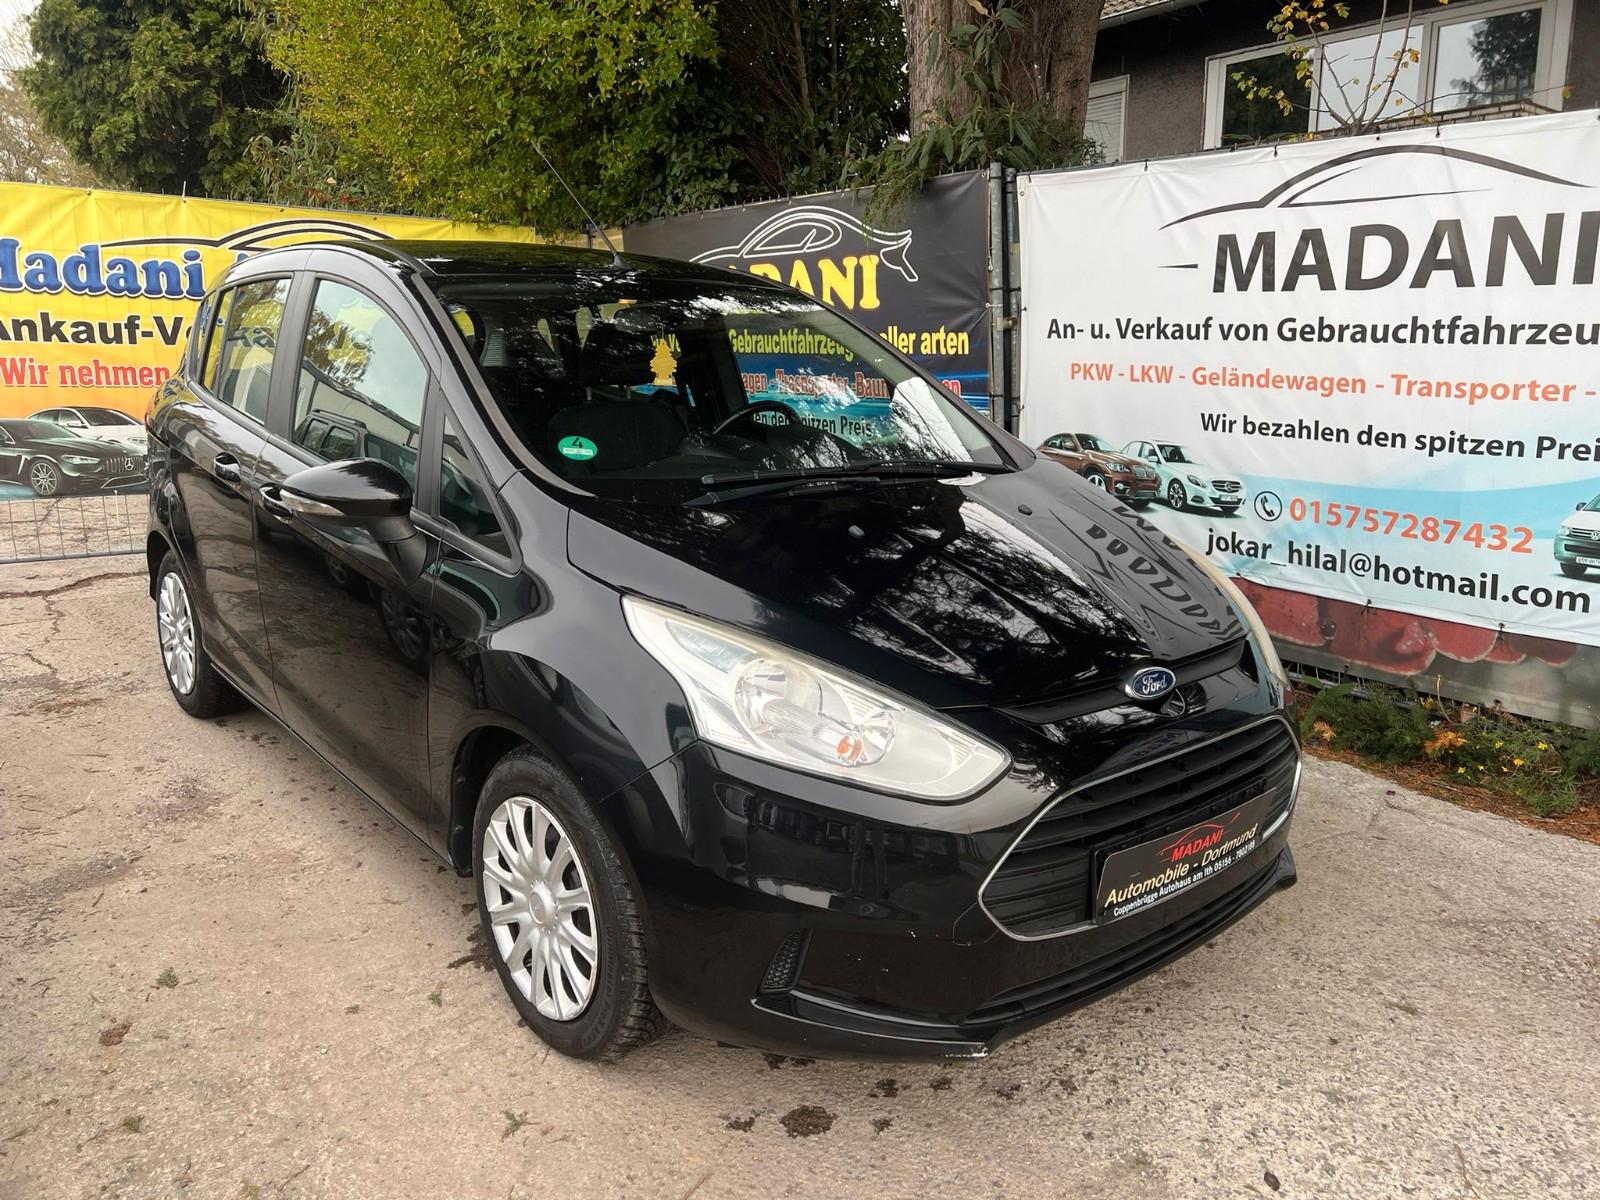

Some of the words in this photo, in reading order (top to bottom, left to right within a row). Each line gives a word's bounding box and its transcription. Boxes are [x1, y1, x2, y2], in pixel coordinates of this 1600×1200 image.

[1212, 210, 1600, 294] MADANI
[920, 325, 970, 355] arten
[1047, 318, 1084, 340] An-
[1090, 322, 1110, 340] u.
[1116, 316, 1213, 341] Verkauf
[1218, 322, 1268, 342] von
[0, 357, 48, 385] Wir
[59, 359, 170, 387] nehmen
[741, 374, 768, 395] agen
[1070, 363, 1113, 382] PKW
[1129, 365, 1174, 384] LKW
[1191, 366, 1366, 397] Geländewagen
[1391, 374, 1576, 404] Transporter
[572, 437, 583, 449] 4
[840, 416, 873, 437] Preis
[1200, 413, 1236, 434] Wir
[1242, 415, 1349, 443] bezahlen
[1356, 424, 1406, 449] den
[1414, 430, 1525, 457] spitzen
[1289, 496, 1533, 554] 015757287432
[1205, 528, 1591, 613] jokar_hilal@hotmail.com
[1142, 673, 1167, 694] Ford
[1171, 829, 1224, 862] MADANI
[1104, 862, 1190, 908] Automobile
[1201, 823, 1258, 867] Dortmund
[1113, 891, 1158, 917] Coppenbrügge
[1159, 875, 1192, 897] Autohaus
[1193, 872, 1203, 882] am
